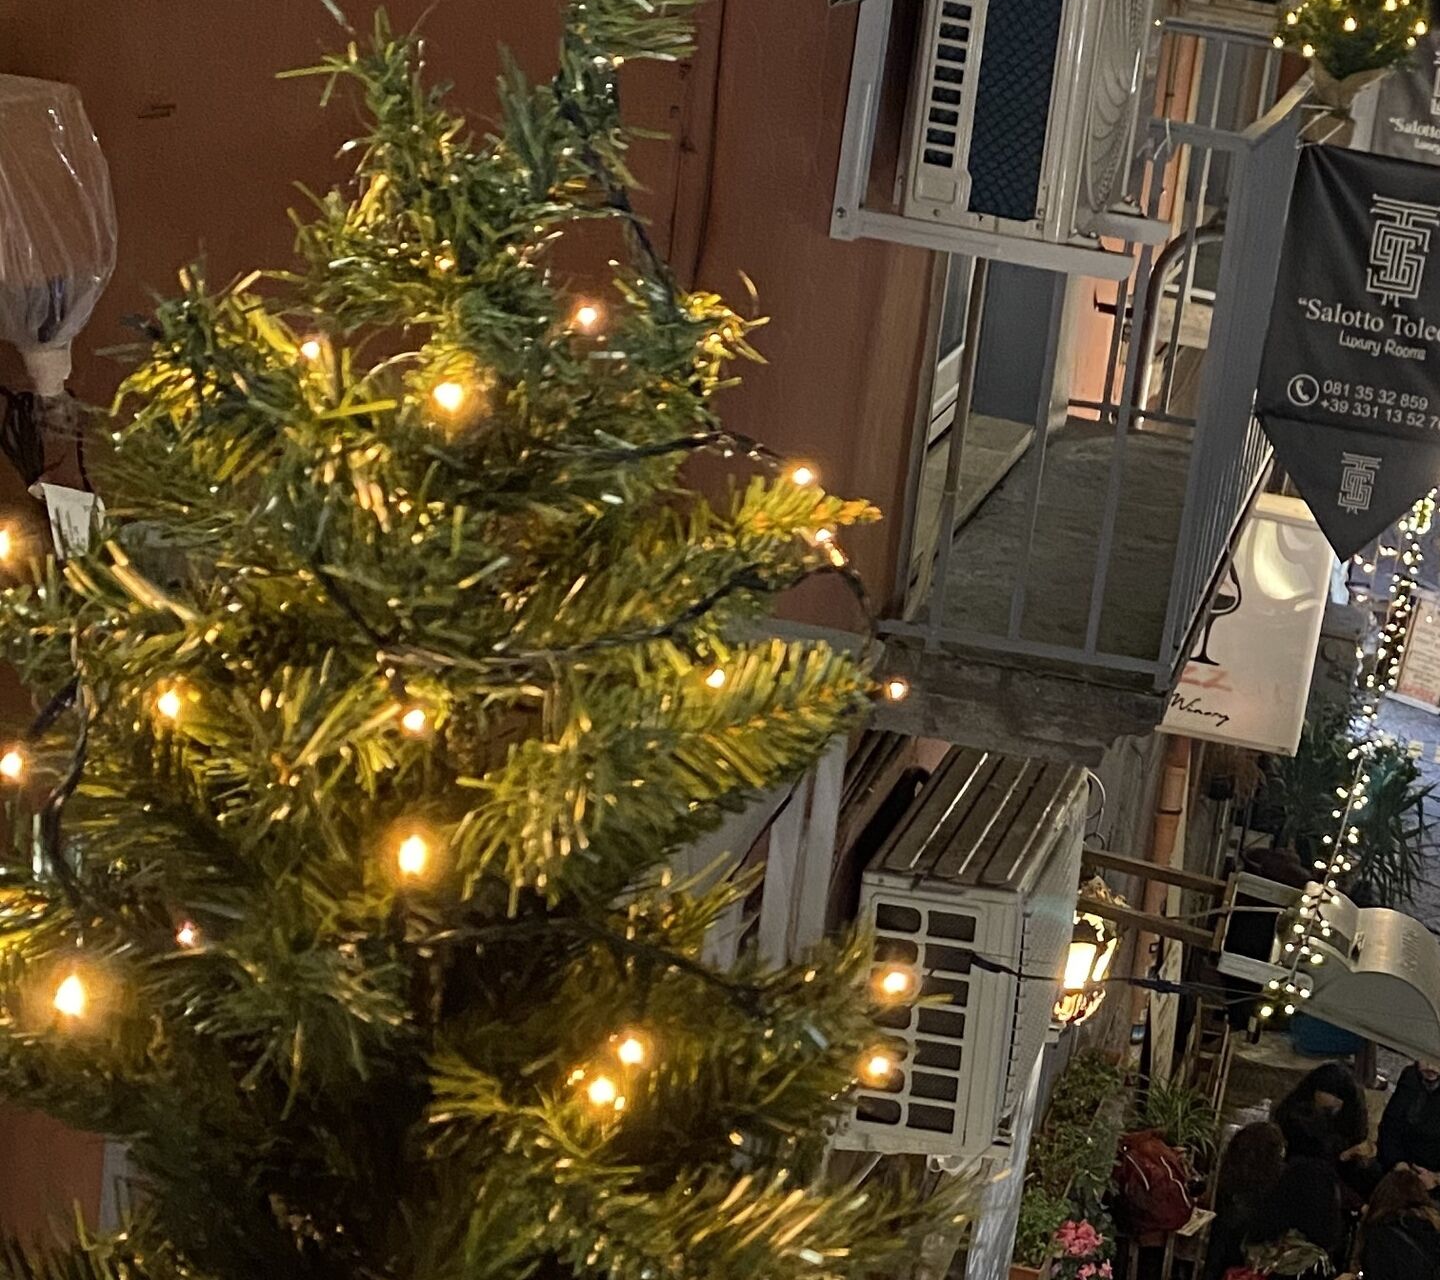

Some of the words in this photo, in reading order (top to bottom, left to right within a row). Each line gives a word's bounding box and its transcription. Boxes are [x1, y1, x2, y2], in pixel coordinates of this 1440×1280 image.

[1339, 330, 1381, 357] Luxury
[1384, 338, 1427, 361] Rooms
[1323, 380, 1350, 397] 081
[1355, 385, 1374, 401] 35
[1377, 389, 1397, 405] 32
[1400, 394, 1429, 410] 859
[1320, 398, 1349, 414] +39
[1352, 403, 1379, 419] 331
[1385, 408, 1402, 422] 13
[1406, 412, 1426, 428] 52
